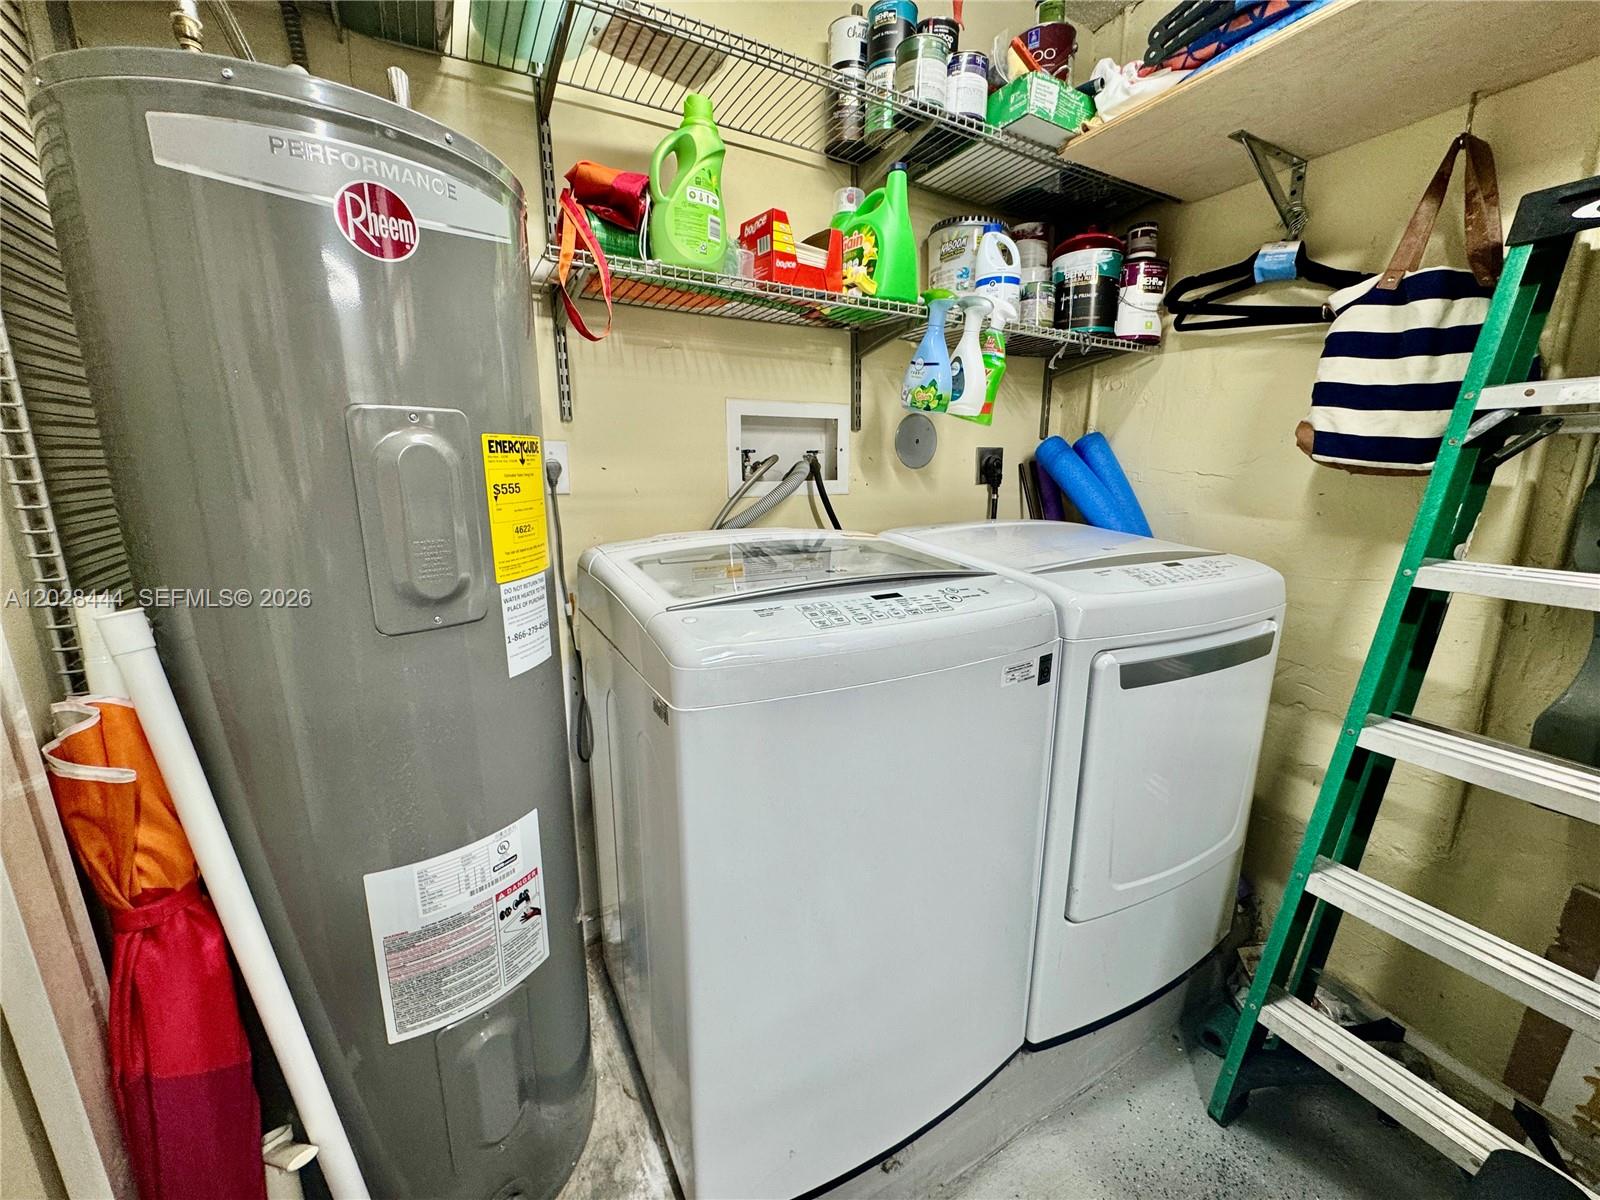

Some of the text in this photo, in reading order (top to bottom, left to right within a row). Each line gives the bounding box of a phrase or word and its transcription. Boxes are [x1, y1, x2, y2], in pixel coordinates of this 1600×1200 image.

[268, 136, 458, 200] PERFORMANCE
[343, 183, 414, 248] Rheem
[775, 259, 796, 269] bounce
[488, 440, 540, 454] ENERGYGUIDE
[493, 482, 521, 495] $555
[515, 523, 531, 535] 4622
[503, 587, 513, 595] DO
[513, 584, 523, 593] NOT
[503, 593, 521, 605] WATER
[507, 603, 522, 613] PLACE
[507, 870, 537, 894] DANGER
